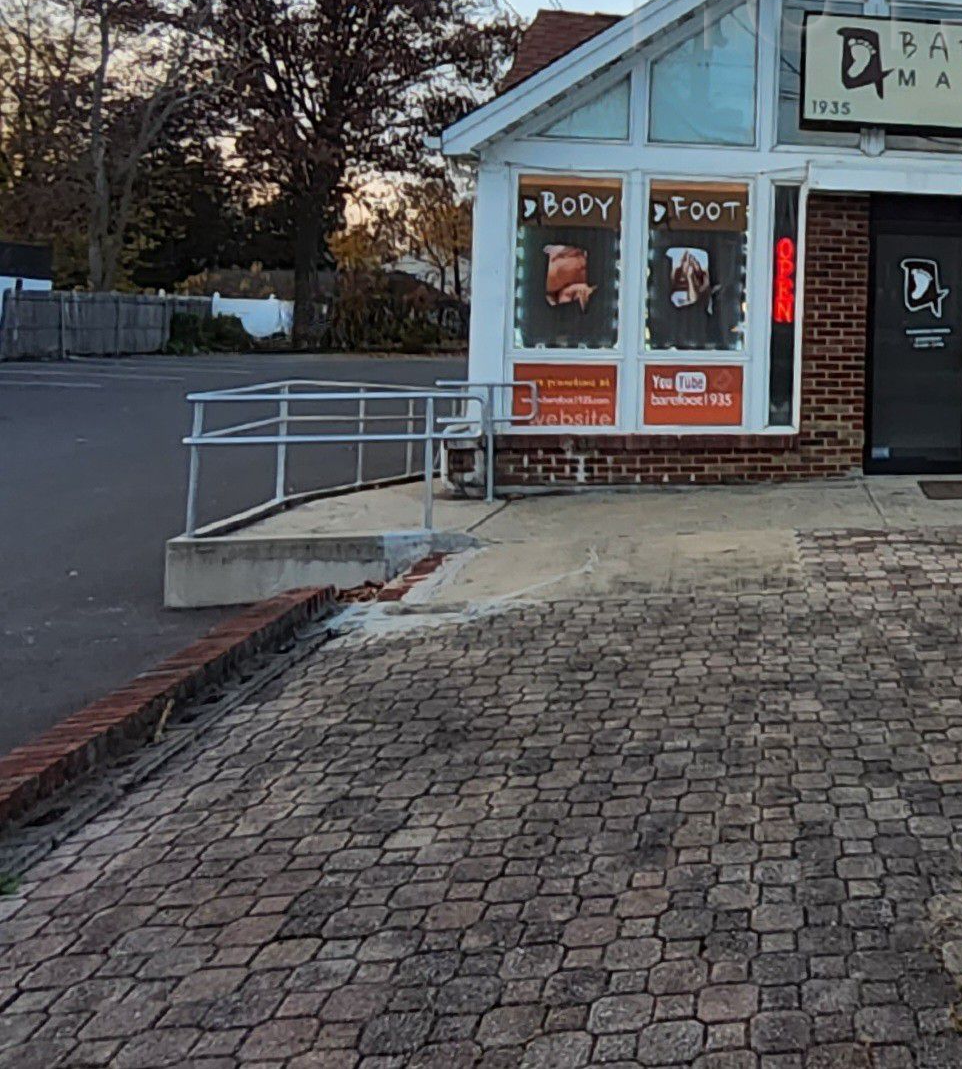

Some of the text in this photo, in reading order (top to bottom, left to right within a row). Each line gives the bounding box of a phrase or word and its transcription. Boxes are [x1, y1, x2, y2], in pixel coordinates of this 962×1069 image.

[812, 100, 852, 116] 1935
[540, 191, 614, 221] BODY
[671, 196, 740, 221] FOOT
[775, 237, 795, 323] OPEN
